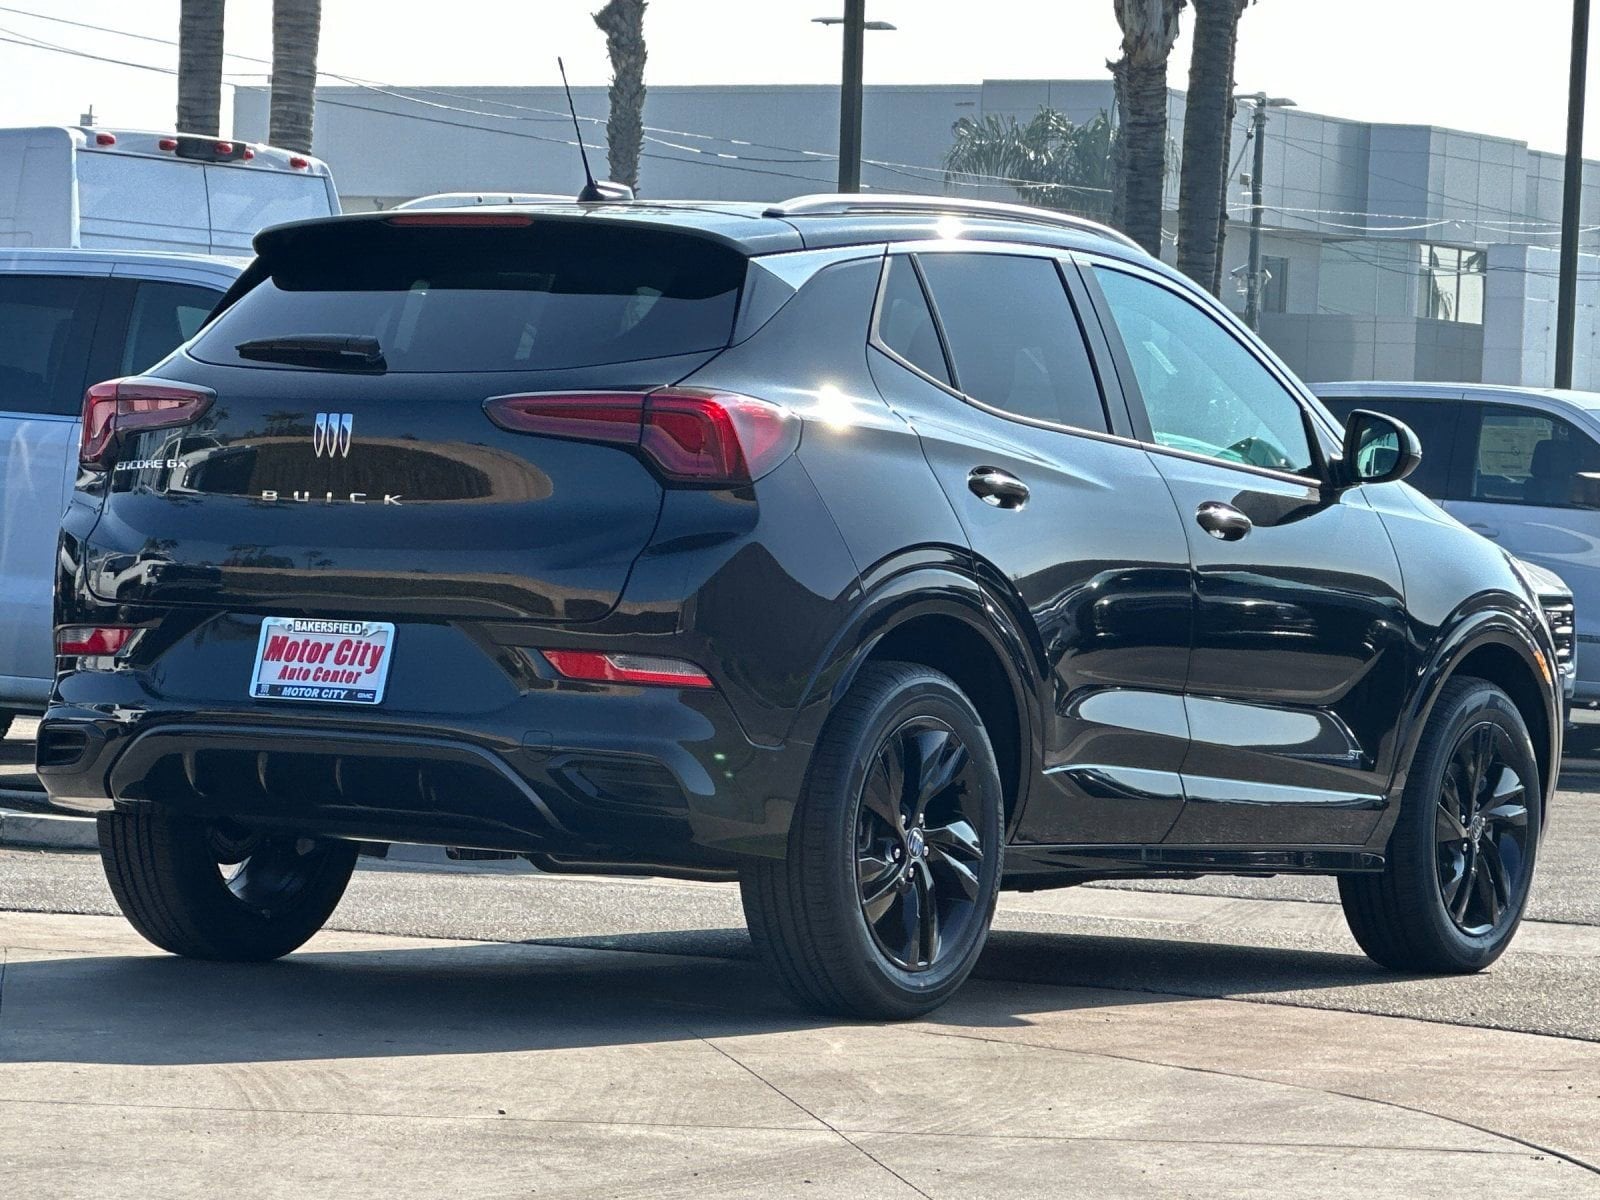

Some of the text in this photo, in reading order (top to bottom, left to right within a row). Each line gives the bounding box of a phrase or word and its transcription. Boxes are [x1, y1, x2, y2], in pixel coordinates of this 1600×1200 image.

[115, 459, 164, 471] ENCORE
[261, 489, 403, 506] BUICK
[294, 621, 362, 634] BAKERSFIELD
[263, 635, 385, 674] Motor City
[278, 665, 362, 685] Auto Center
[281, 686, 348, 699] MOTOR CITY
